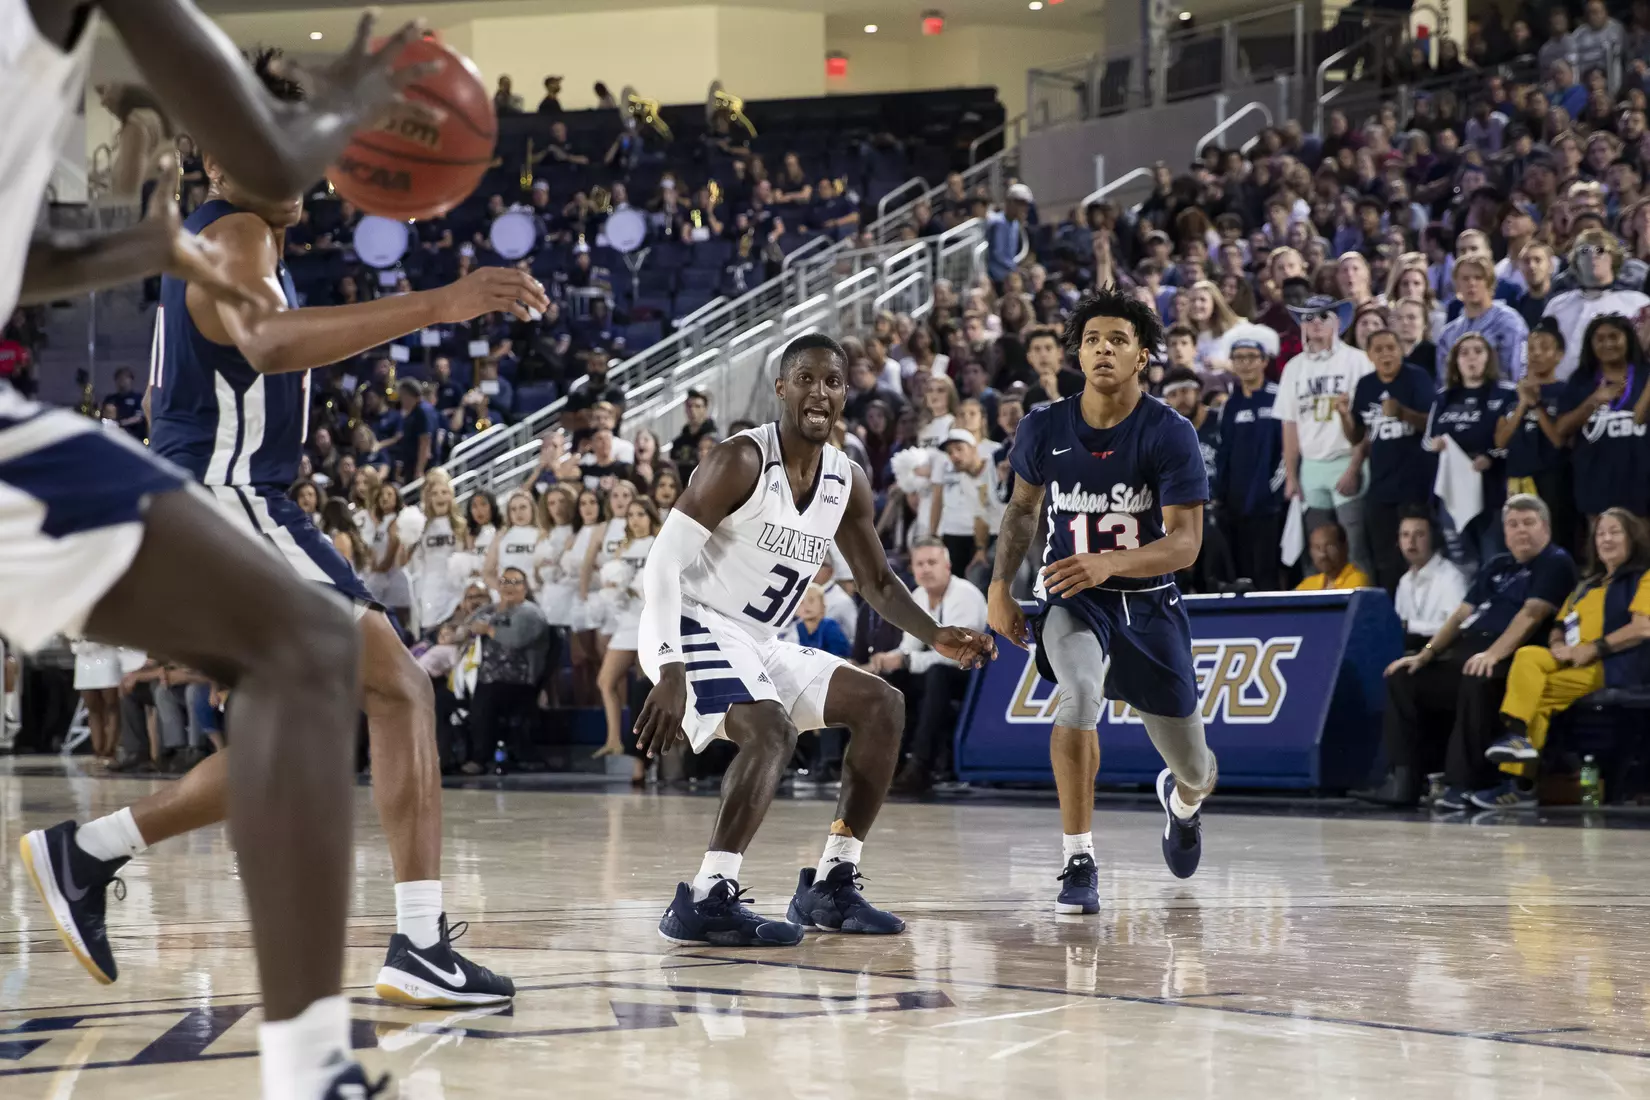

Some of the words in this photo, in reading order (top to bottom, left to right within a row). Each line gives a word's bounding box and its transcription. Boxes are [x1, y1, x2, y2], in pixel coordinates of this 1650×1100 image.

[823, 494, 839, 505] WAC
[1051, 480, 1109, 515] Jackson
[1110, 482, 1153, 514] State
[1069, 512, 1140, 556] 13
[742, 563, 812, 627] 31
